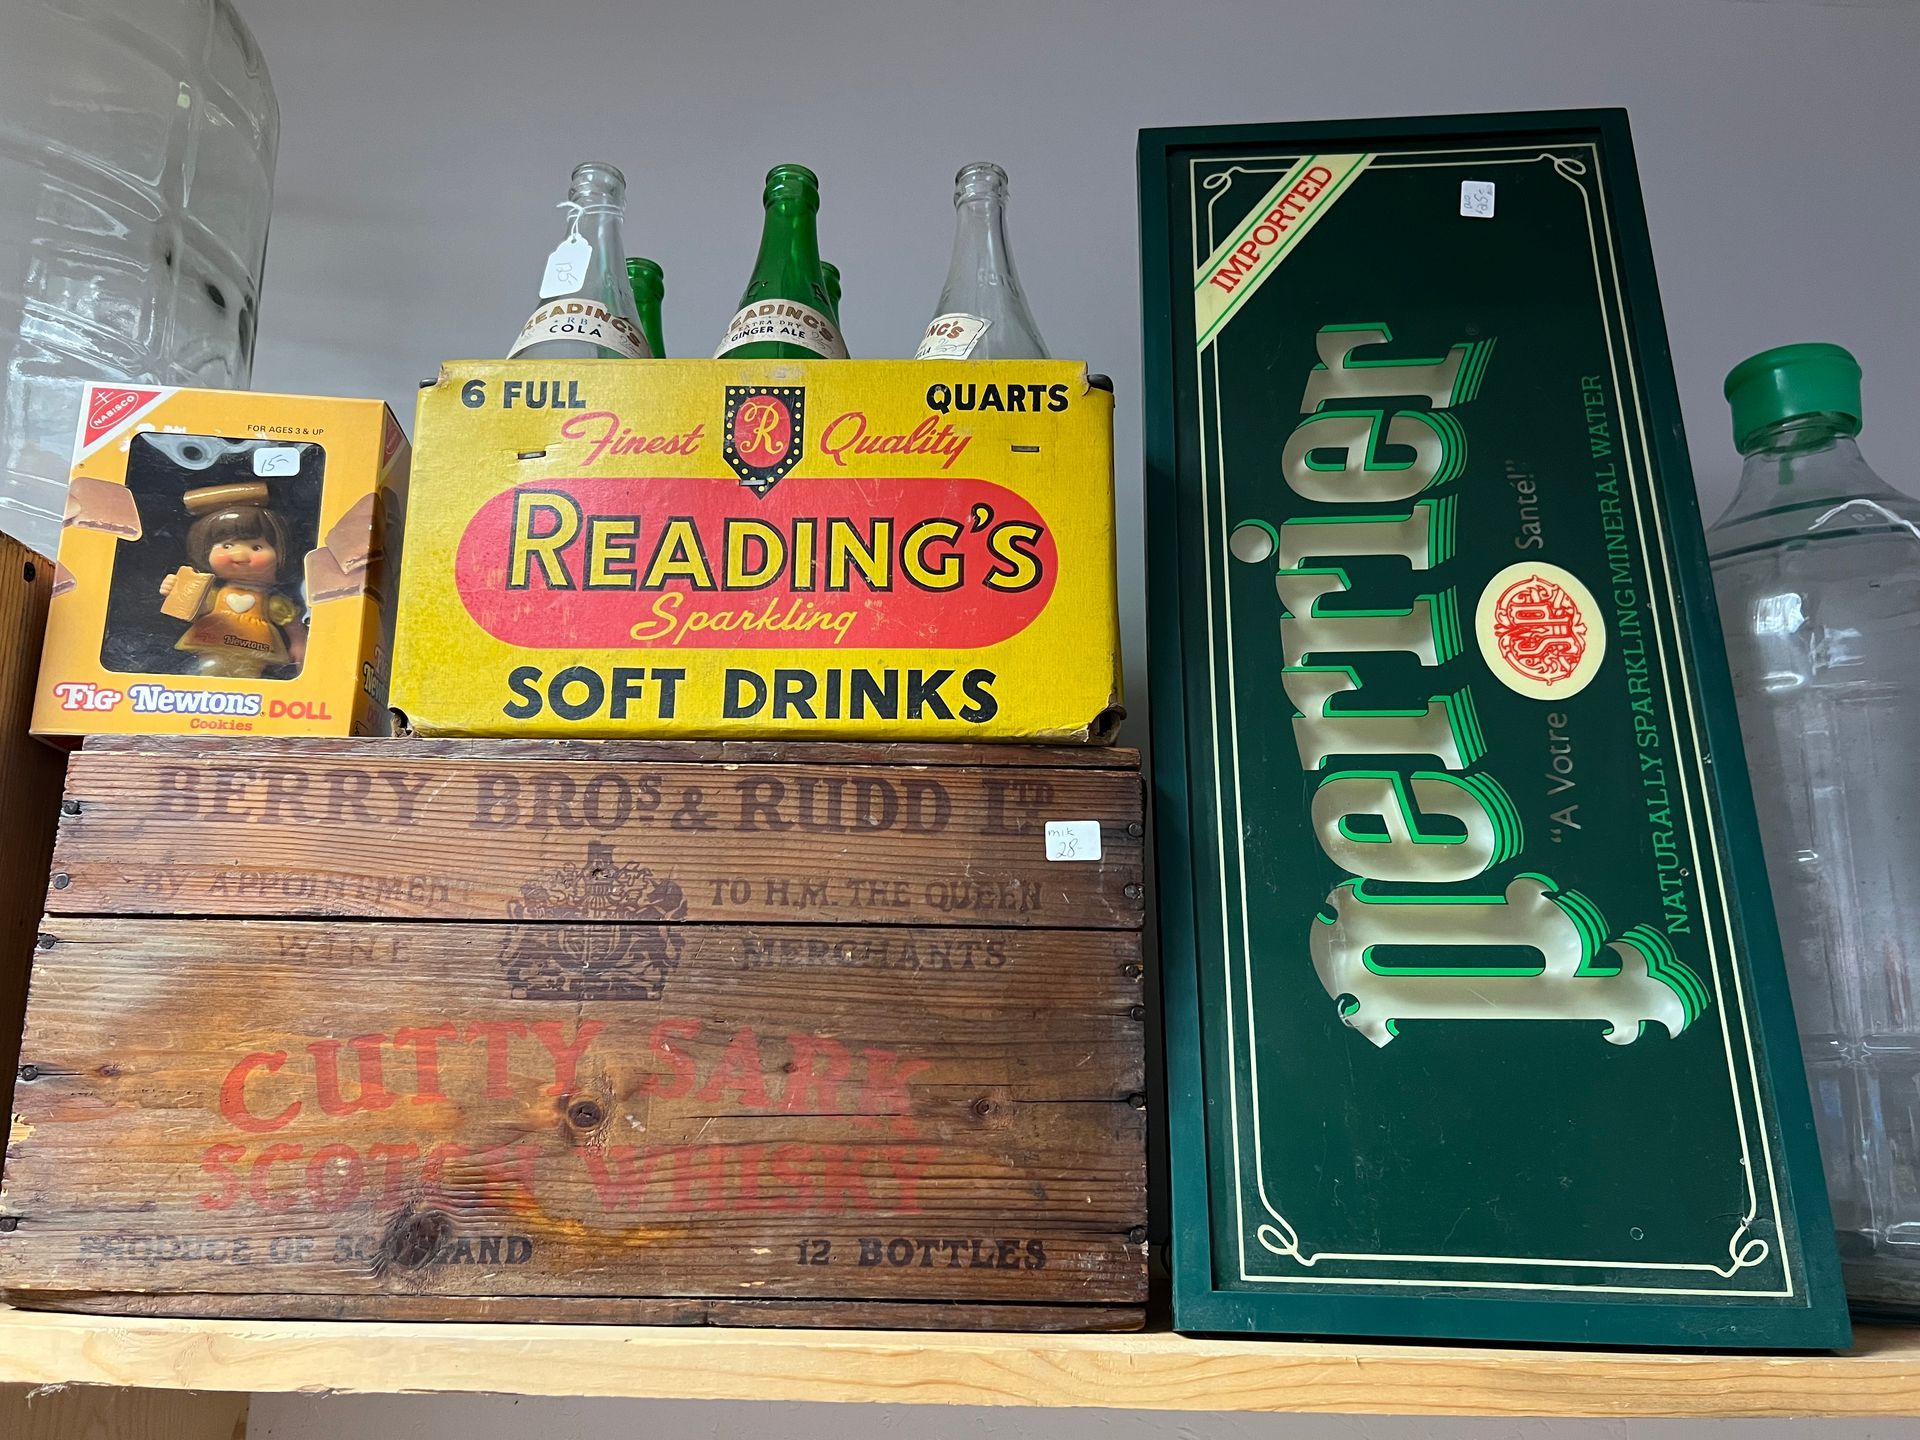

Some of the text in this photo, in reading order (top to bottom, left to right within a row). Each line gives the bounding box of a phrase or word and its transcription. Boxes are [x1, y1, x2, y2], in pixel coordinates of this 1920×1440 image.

[1210, 166, 1333, 294] IMPORTED
[549, 324, 602, 338] COLA
[729, 303, 834, 343] EADING'S
[731, 326, 805, 342] GINGER ALE
[779, 320, 802, 329] DRY
[93, 394, 137, 430] NABISCO
[462, 381, 587, 409] 6 FULL
[926, 383, 1070, 414] QUARTS
[247, 424, 325, 437] FOR AGES 3 & UP
[562, 411, 972, 469] Finest Quality
[740, 401, 784, 455] R
[629, 591, 859, 645] Sparkling
[223, 634, 271, 652] Newtons
[1581, 374, 1690, 934] NATURALLY SPARKLING MINERAL WATER
[127, 684, 263, 716] Newtons
[268, 699, 332, 721] DOLL
[502, 667, 999, 723] SOFT DRINKS
[190, 717, 253, 731] Cookies
[1543, 711, 1575, 797] Votre
[160, 765, 438, 824] BERRY
[670, 785, 719, 833] &
[734, 776, 953, 836] RUDD
[142, 871, 185, 899] BY
[708, 880, 753, 907] TO
[848, 880, 915, 908] THE
[923, 880, 1043, 914] QUEEN
[743, 938, 1008, 971] MERCHANTS
[219, 1019, 930, 1140] CUTTY SARK
[198, 1142, 941, 1214] SCOTCH WHISKY
[269, 1235, 314, 1265] OF
[798, 1239, 832, 1266] 12
[858, 1237, 1048, 1270] BOTTLES
